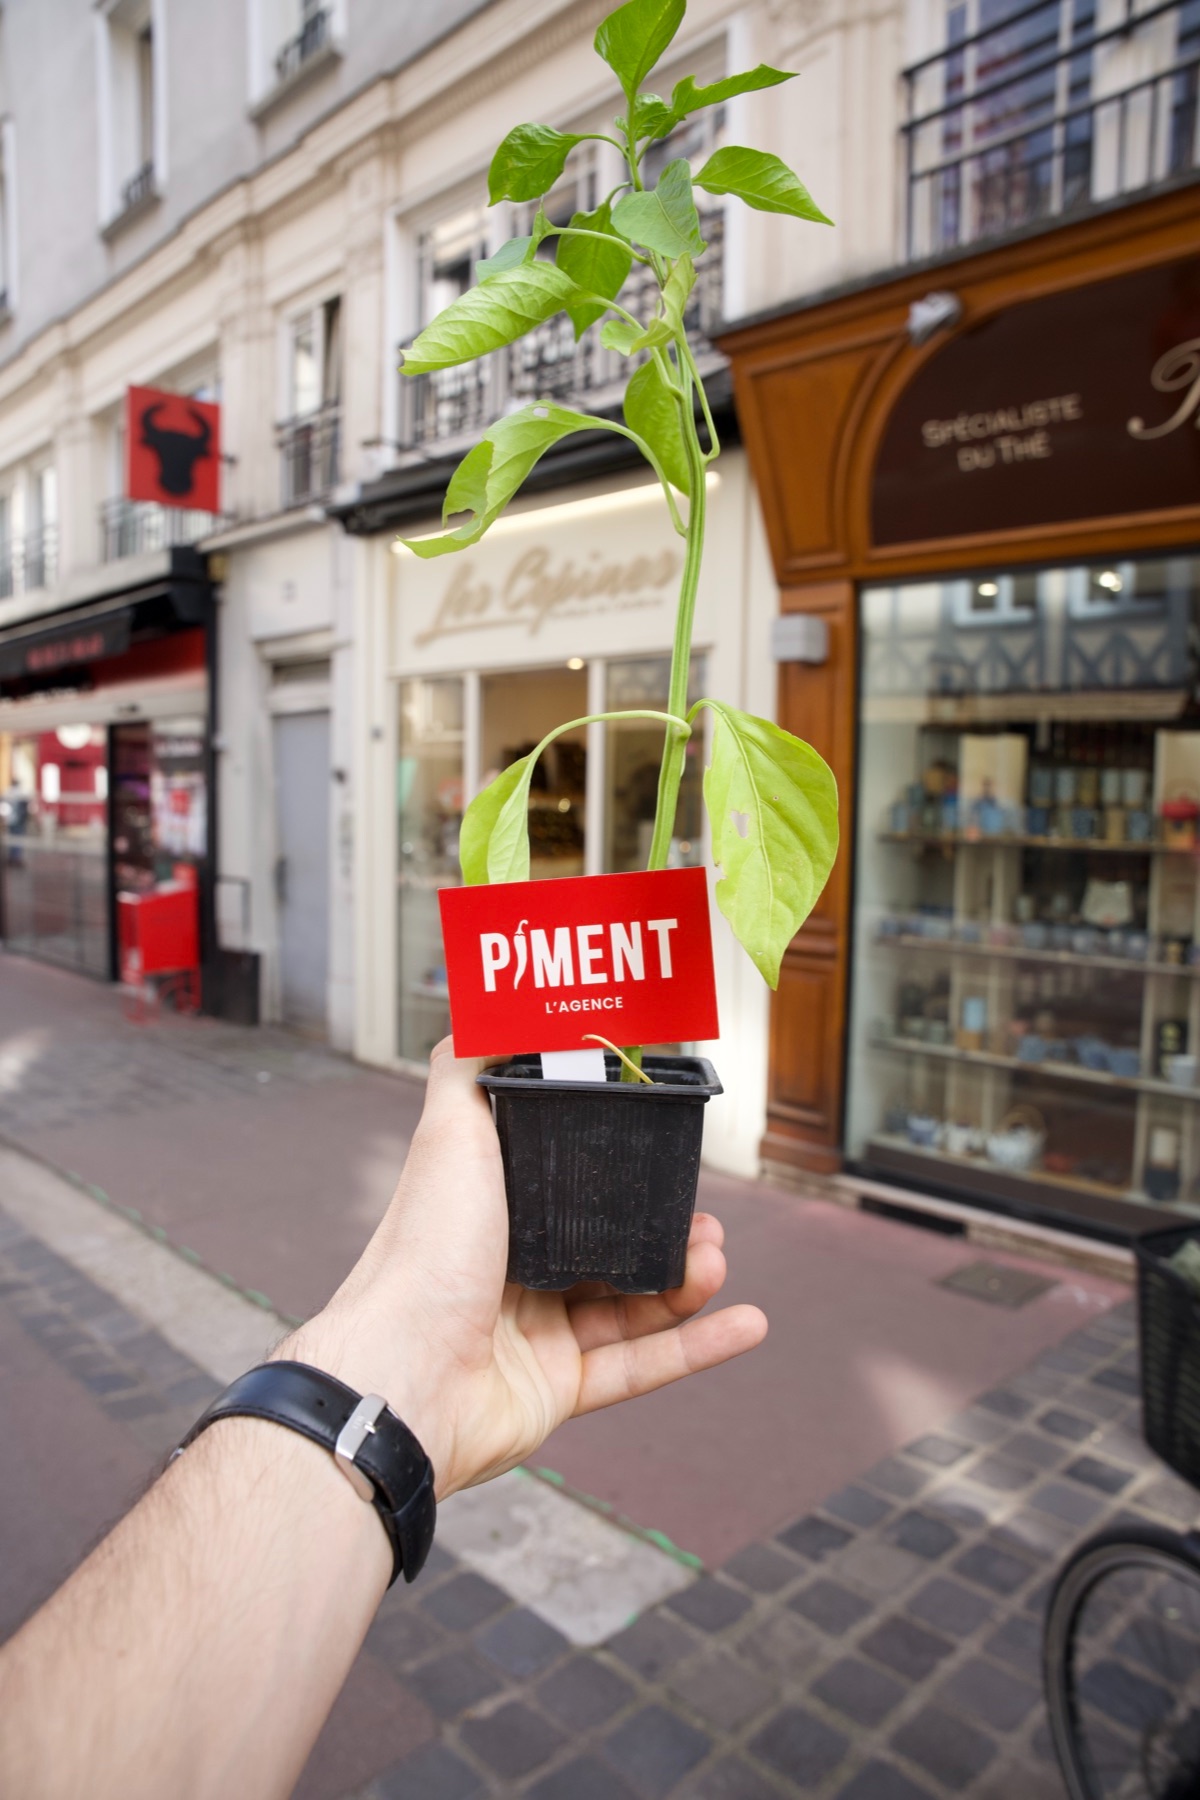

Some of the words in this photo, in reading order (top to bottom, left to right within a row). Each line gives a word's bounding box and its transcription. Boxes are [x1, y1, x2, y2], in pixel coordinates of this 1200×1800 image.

[957, 446, 996, 472] DU
[480, 918, 678, 993] PIMENT
[545, 996, 623, 1014] L'AGENCE
